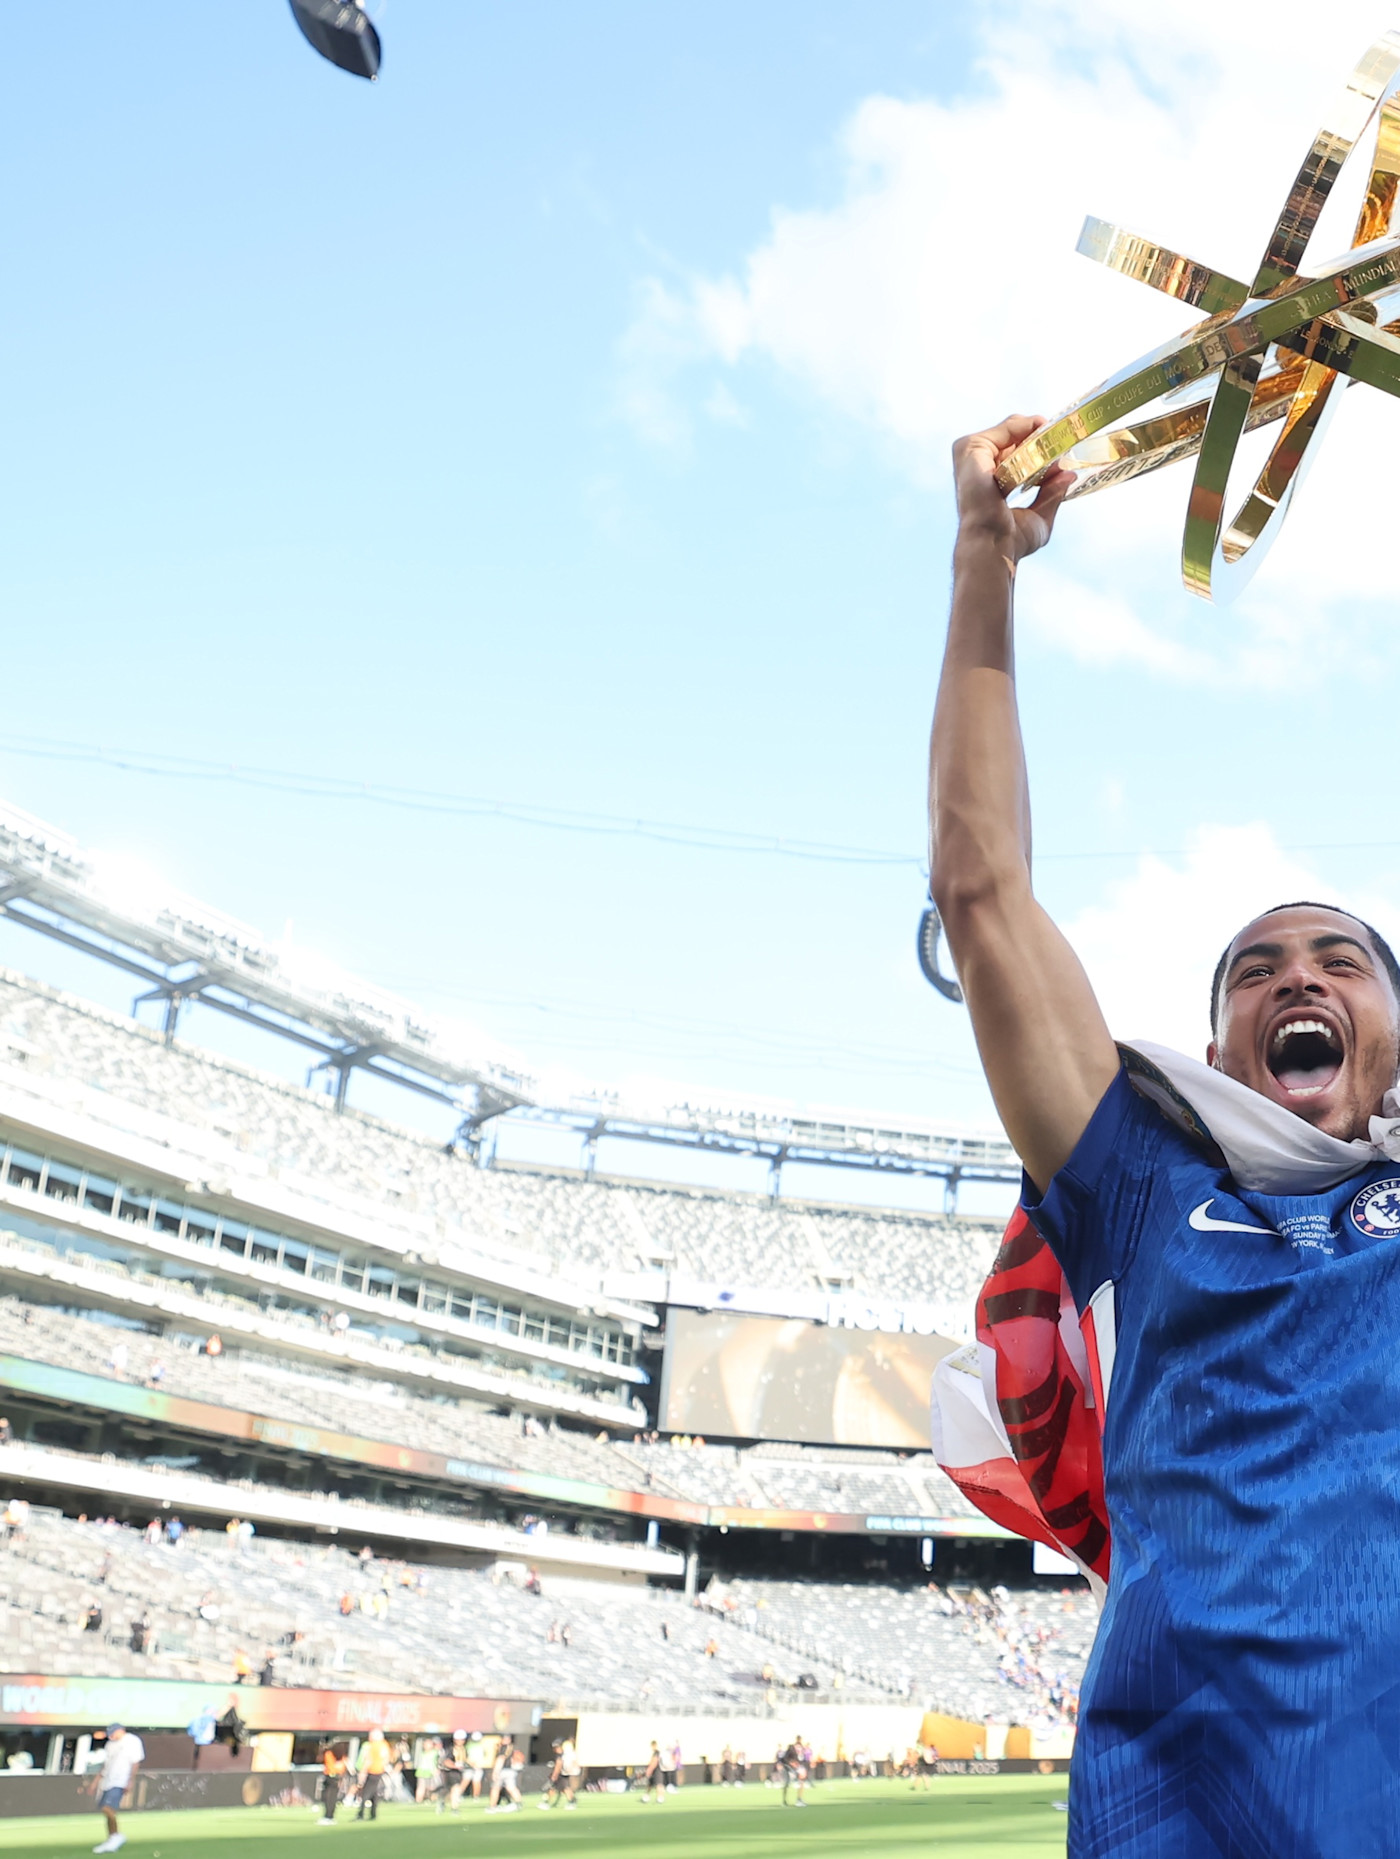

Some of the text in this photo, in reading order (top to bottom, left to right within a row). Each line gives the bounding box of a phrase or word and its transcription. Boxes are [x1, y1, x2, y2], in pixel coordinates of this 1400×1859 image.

[1086, 405, 1106, 424] CUP
[1112, 383, 1144, 409] COUPE
[1146, 374, 1163, 391] DU
[1343, 261, 1399, 292] MUNDIAL
[1286, 1215, 1307, 1225] CLUB
[1290, 1224, 1301, 1232] FC
[1292, 1231, 1321, 1240] SUNDAY
[1298, 1239, 1320, 1249] YORK,
[2, 1684, 85, 1715] WORLD
[336, 1697, 421, 1726] FINAL 2025
[968, 1760, 999, 1775] 2025
